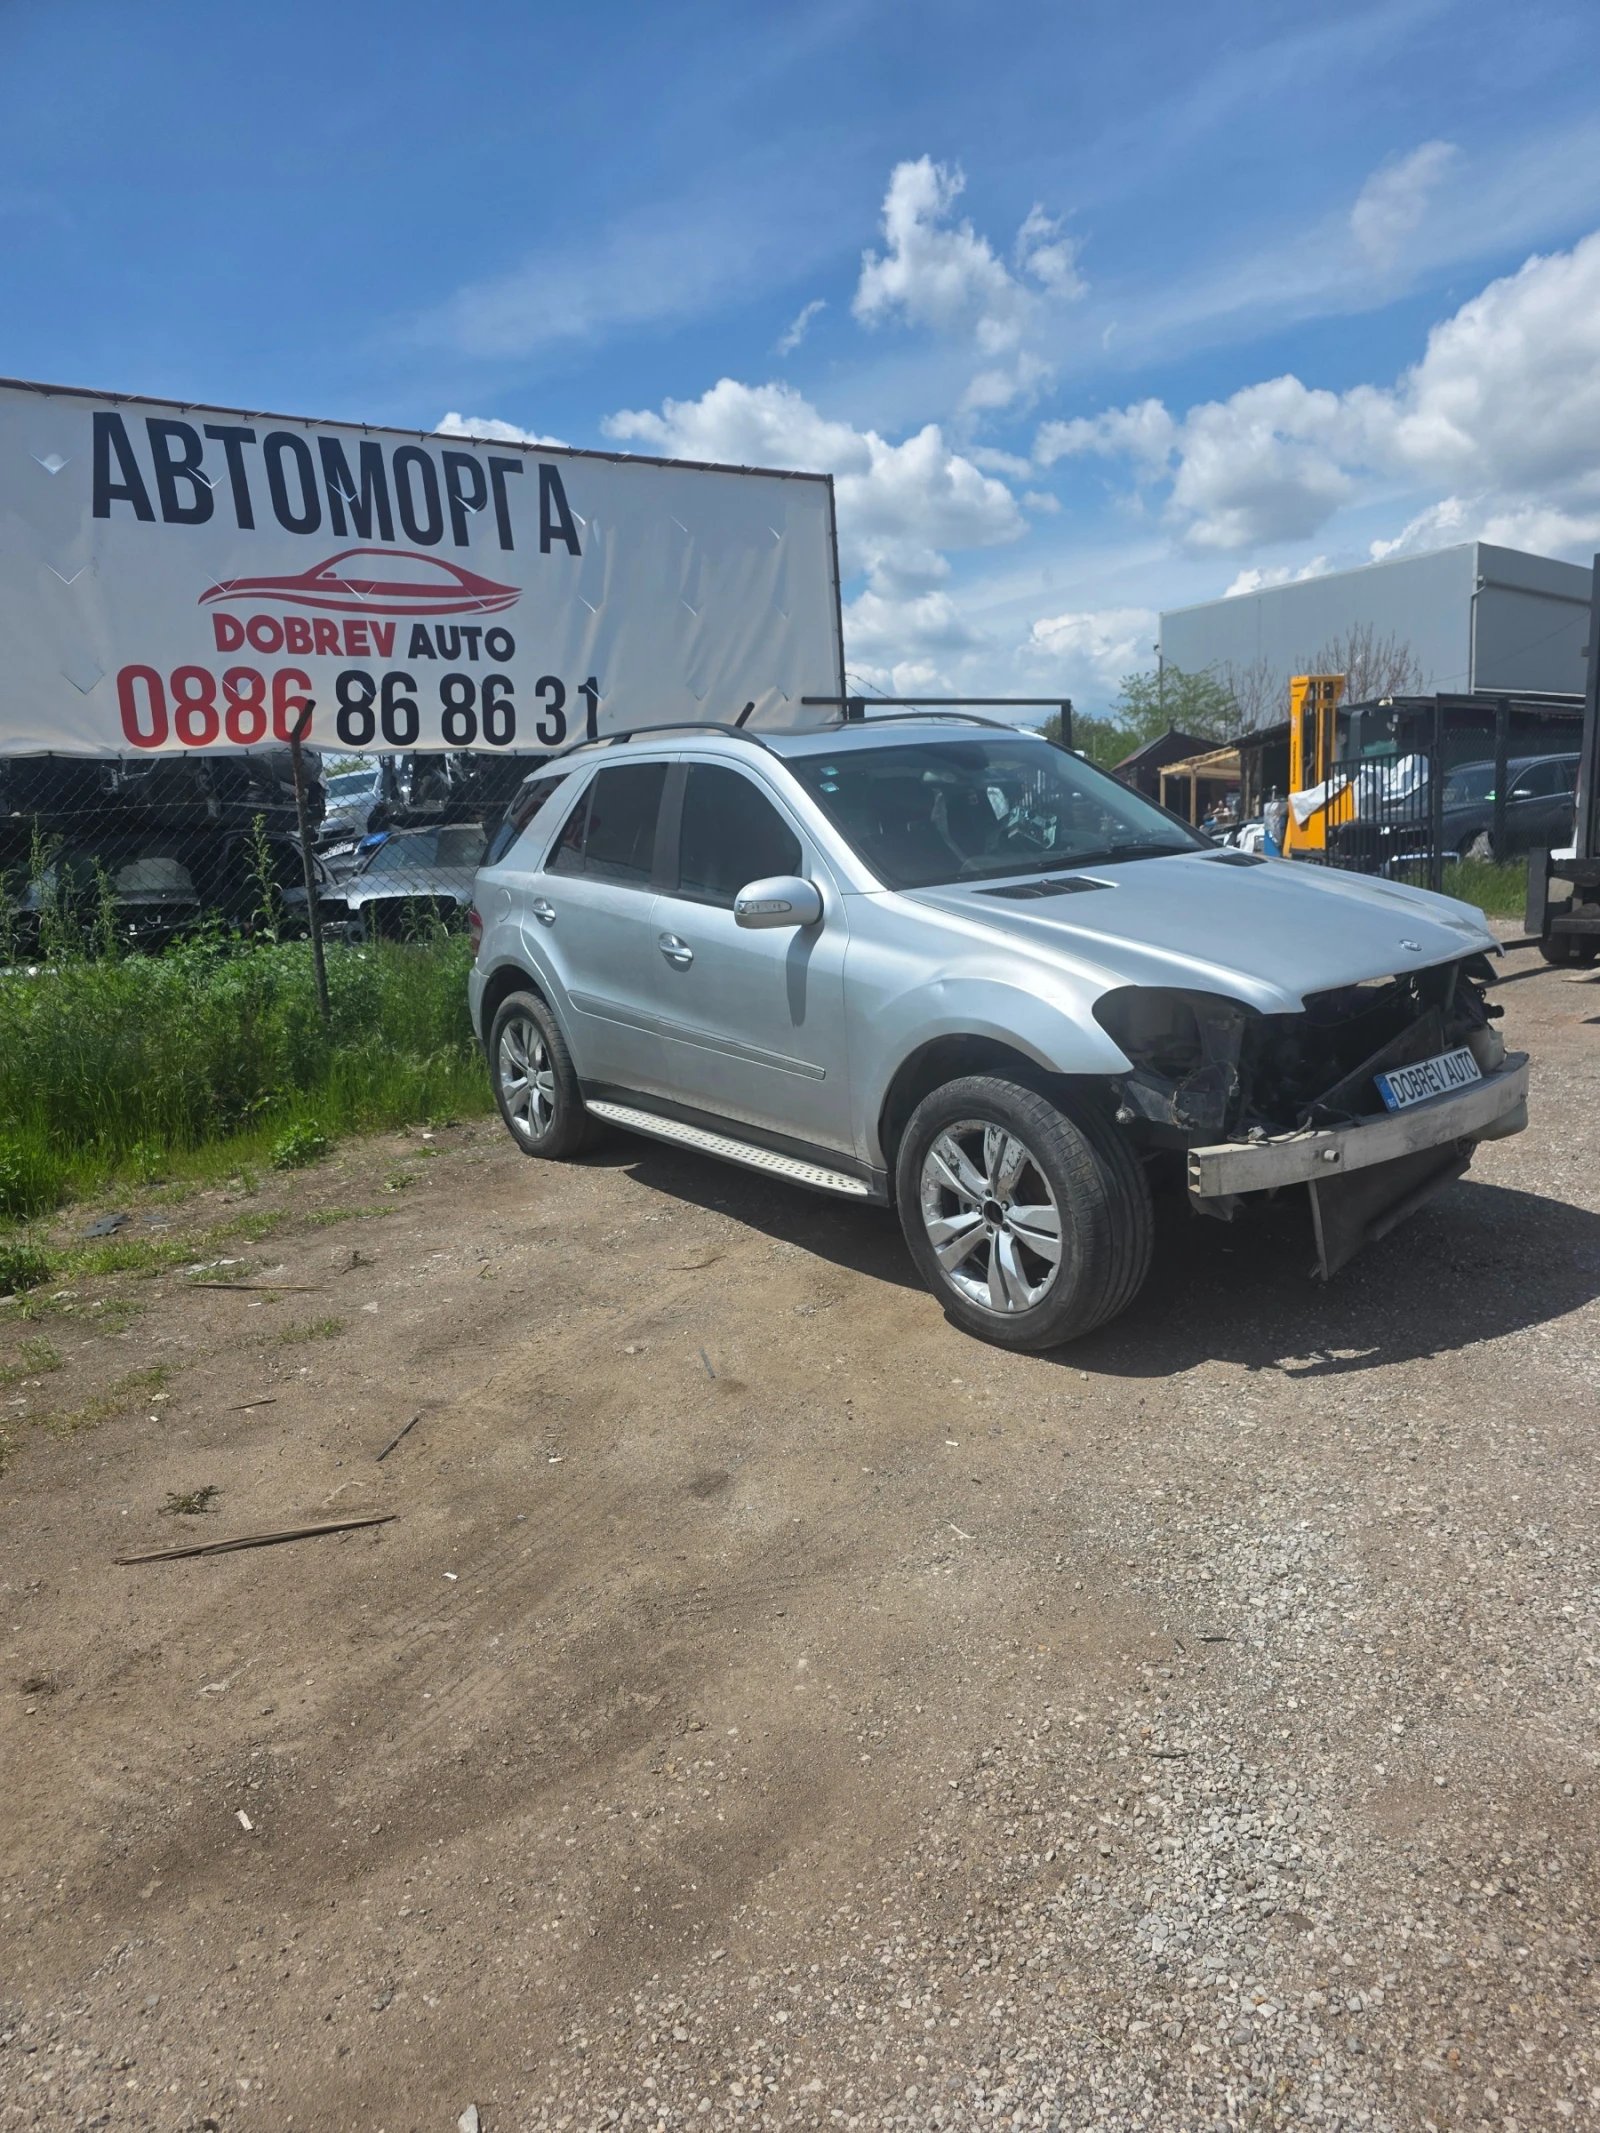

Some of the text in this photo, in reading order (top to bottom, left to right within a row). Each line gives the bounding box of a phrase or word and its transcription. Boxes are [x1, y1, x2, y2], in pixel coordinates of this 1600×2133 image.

[93, 412, 582, 556] АВТОМОРГА
[212, 613, 516, 662] DOBREV AUTO
[117, 664, 599, 748] 0886 86 86 31
[1389, 1052, 1478, 1103] DOBREV AUTO
